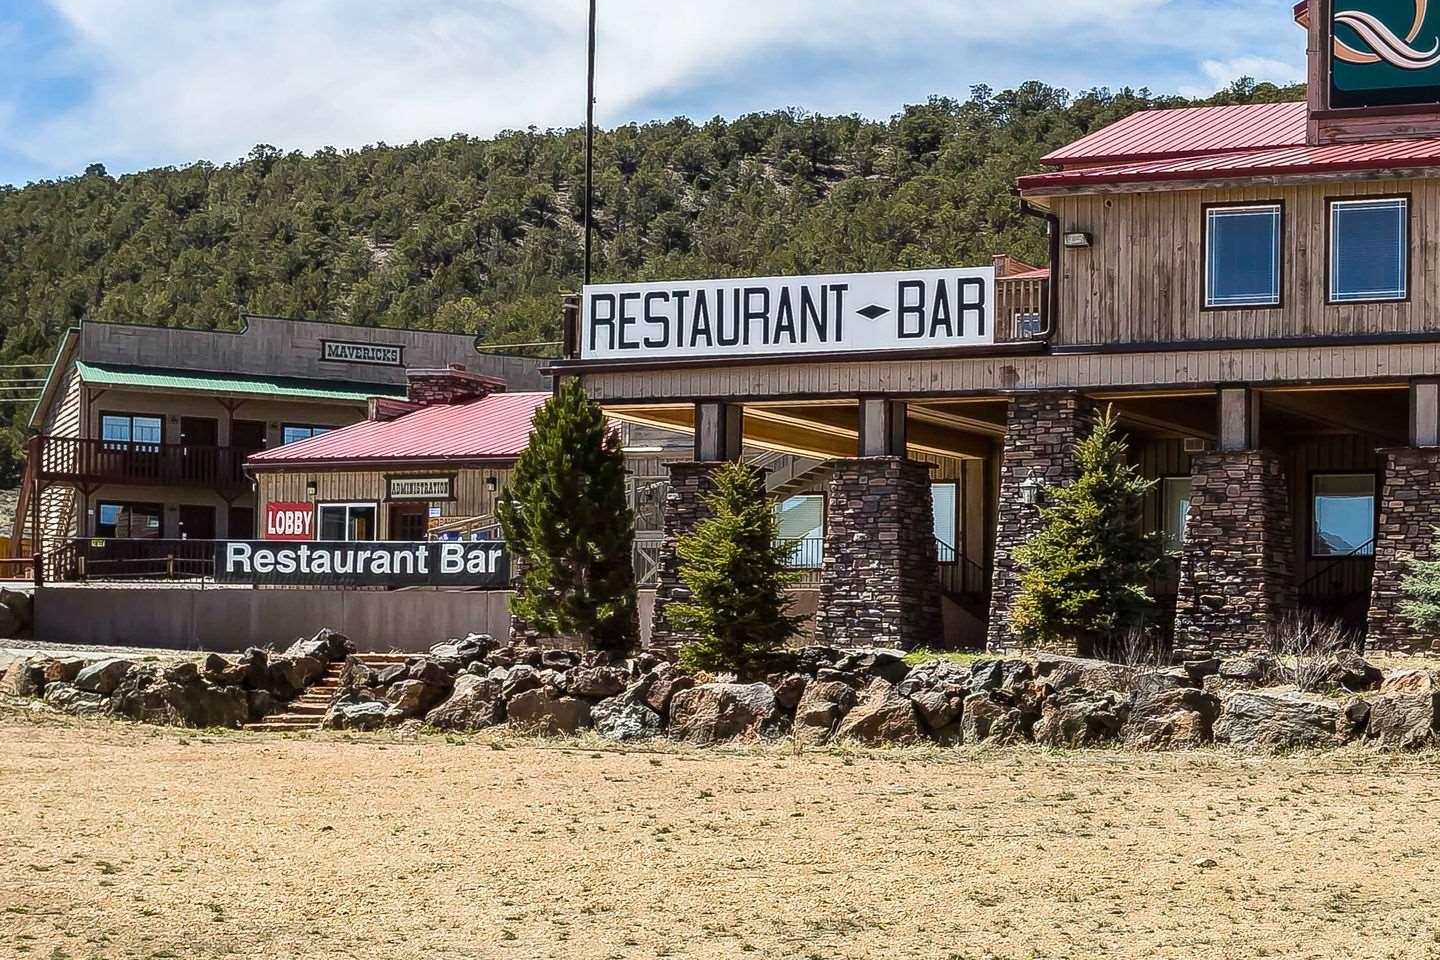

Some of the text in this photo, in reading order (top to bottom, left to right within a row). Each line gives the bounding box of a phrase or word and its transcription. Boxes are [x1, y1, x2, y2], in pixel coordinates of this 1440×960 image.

[589, 277, 986, 351] RESTAURANT BAR
[327, 344, 398, 362] MAVERICKS
[391, 481, 449, 495] ADMINISTRATION
[267, 510, 313, 535] LOBBY
[225, 542, 502, 574] Restaurant Bar
